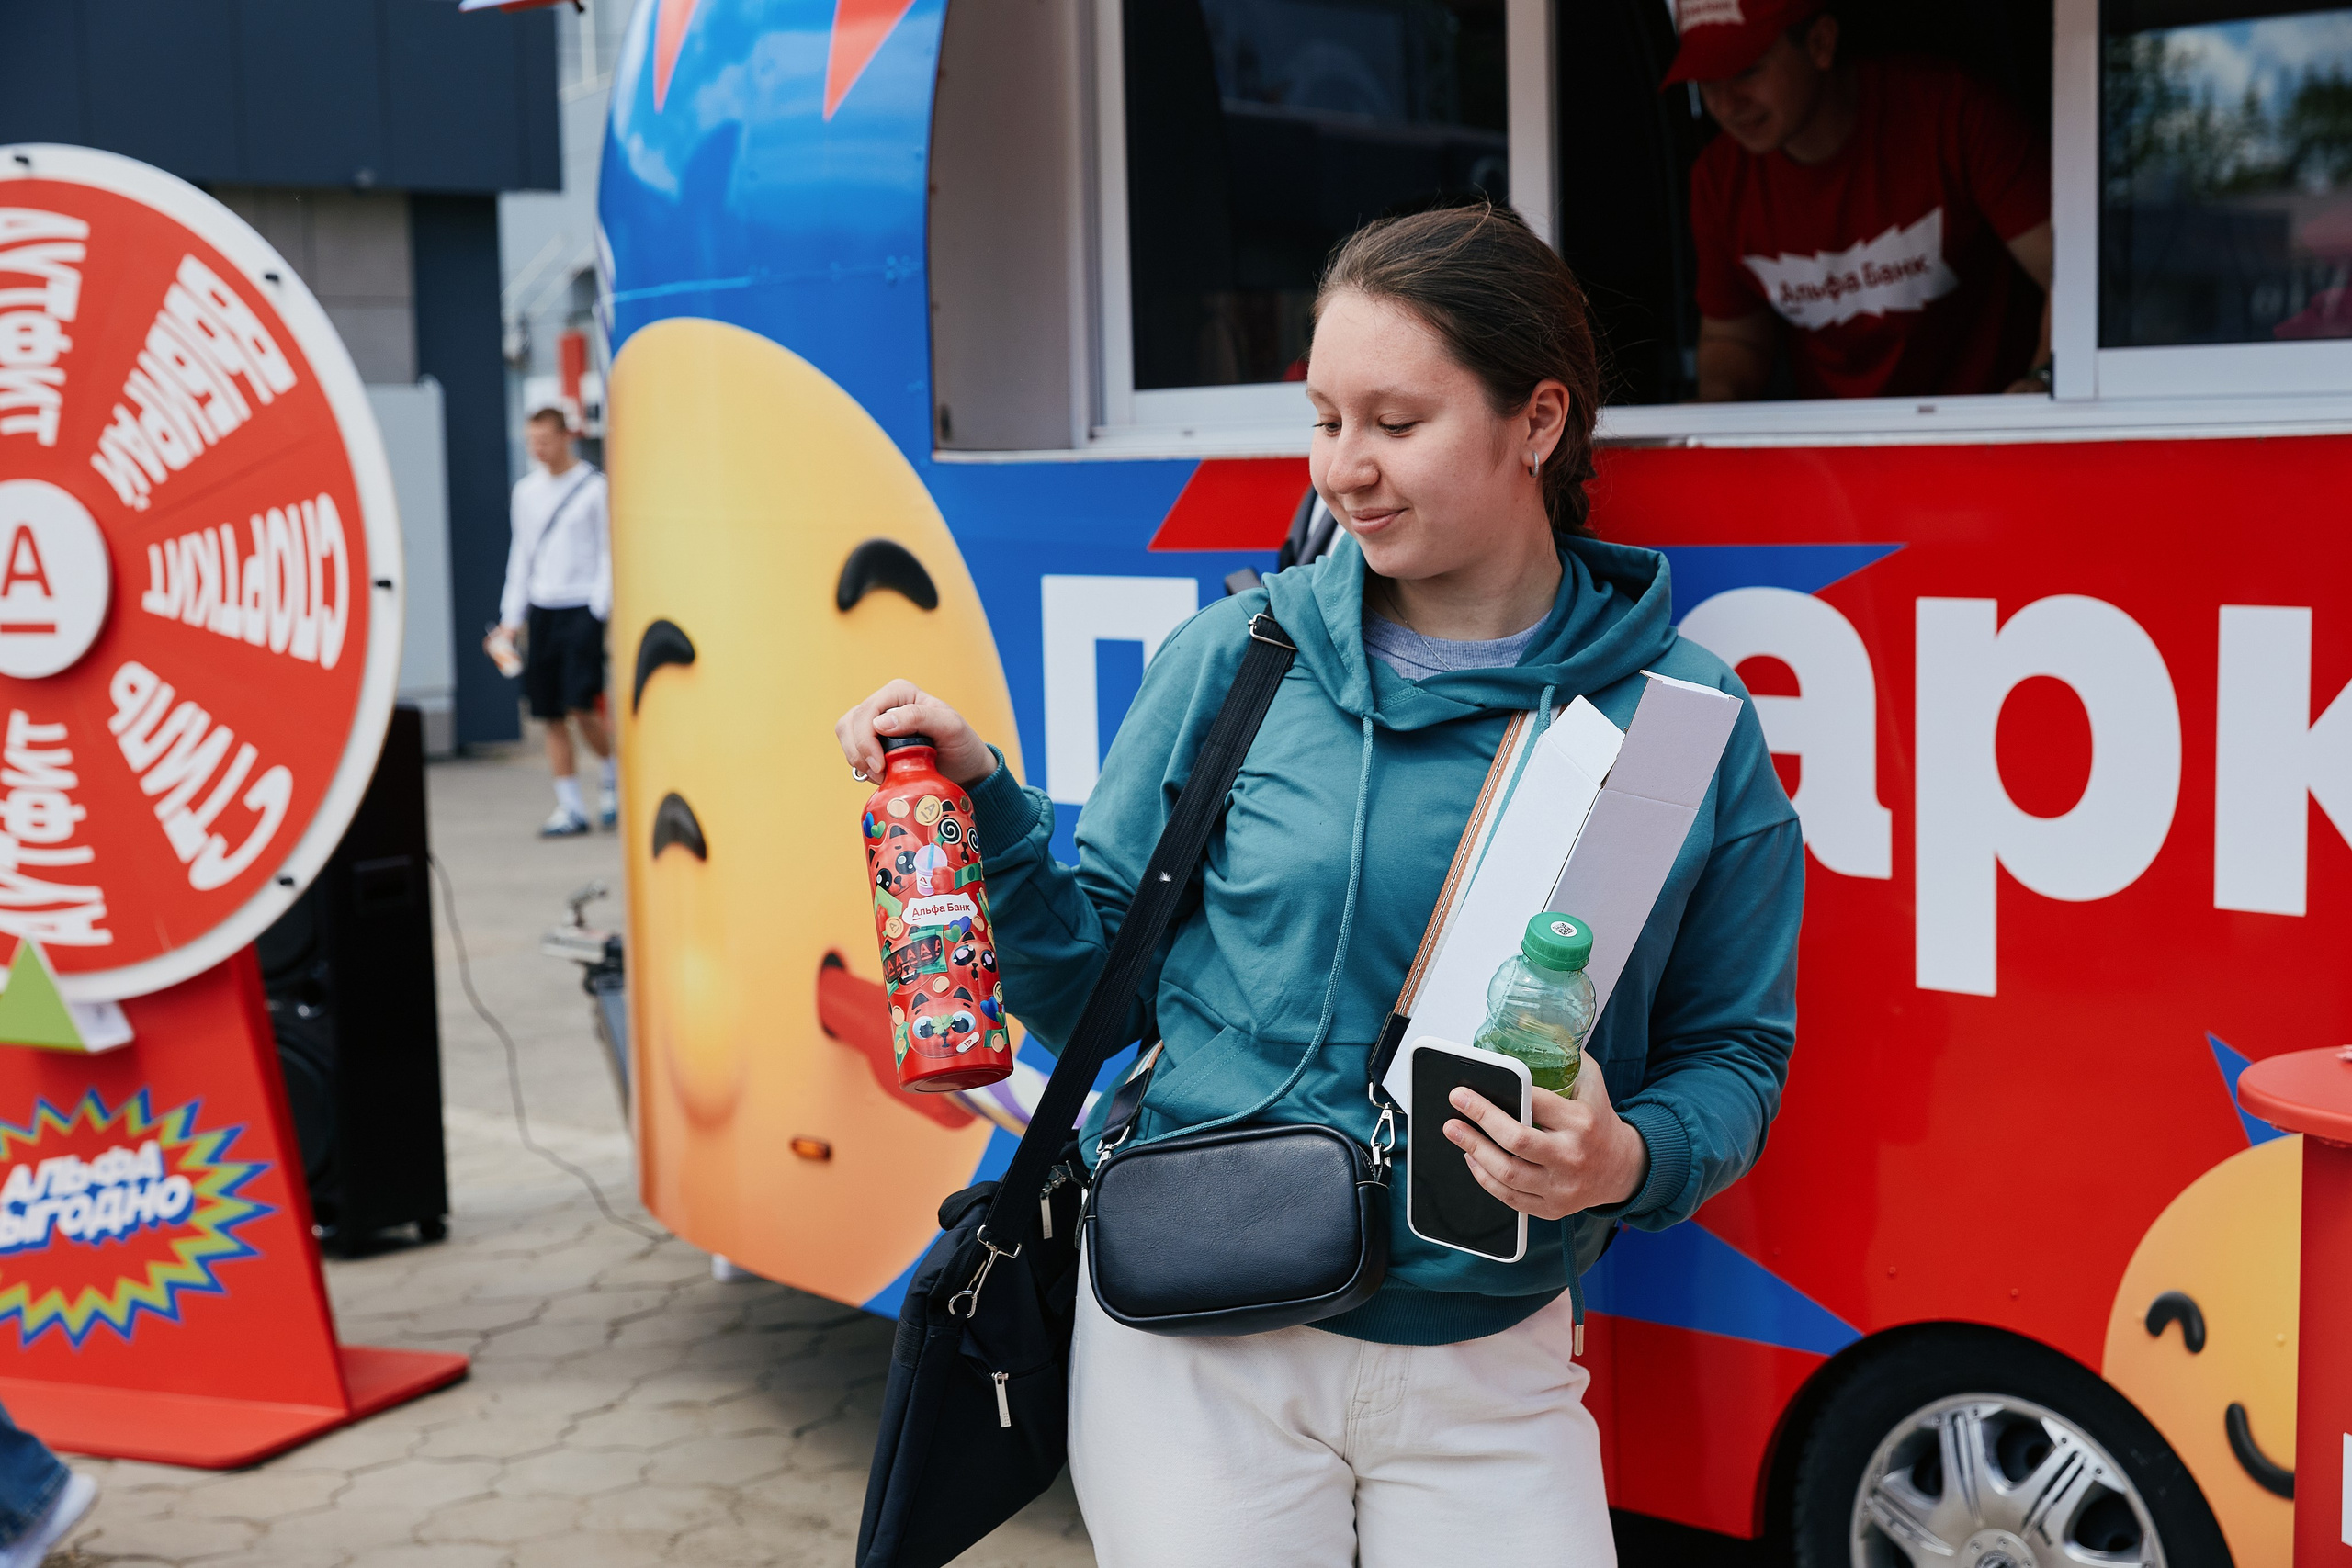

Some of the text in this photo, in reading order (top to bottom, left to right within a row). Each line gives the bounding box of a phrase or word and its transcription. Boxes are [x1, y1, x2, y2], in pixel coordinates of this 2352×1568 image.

[1779, 254, 1930, 309] Альфа Банк
[90, 254, 299, 511] ВЫБИРАЙ
[141, 491, 351, 671] СПОРТКИТ
[0, 709, 113, 947] АУТФИТ
[107, 660, 294, 891] СТИЛЬ
[911, 902, 971, 919] Альфа Банк
[0, 1140, 164, 1205] АЛЬФА
